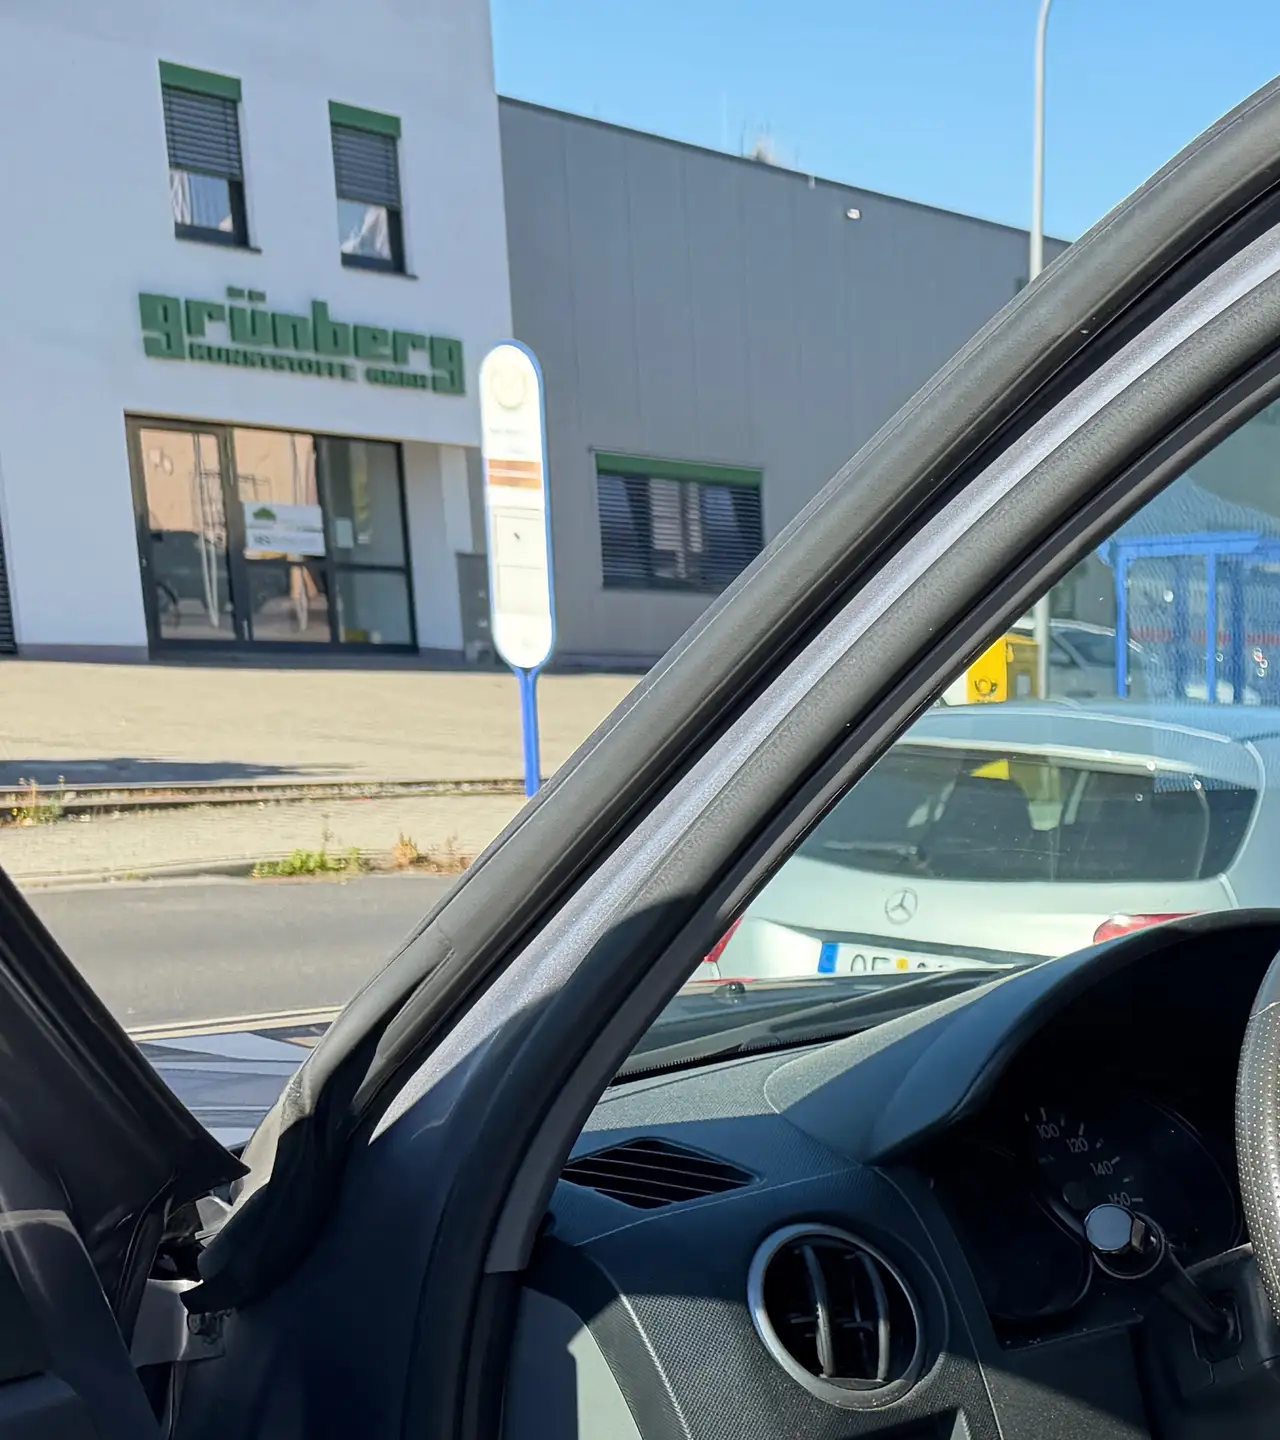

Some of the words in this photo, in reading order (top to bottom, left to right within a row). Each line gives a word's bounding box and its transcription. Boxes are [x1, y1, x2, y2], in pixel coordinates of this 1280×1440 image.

[138, 285, 466, 396] grünberg
[1036, 1123, 1060, 1140] 100
[1066, 1136, 1089, 1154] 120
[1090, 1161, 1114, 1176] 140
